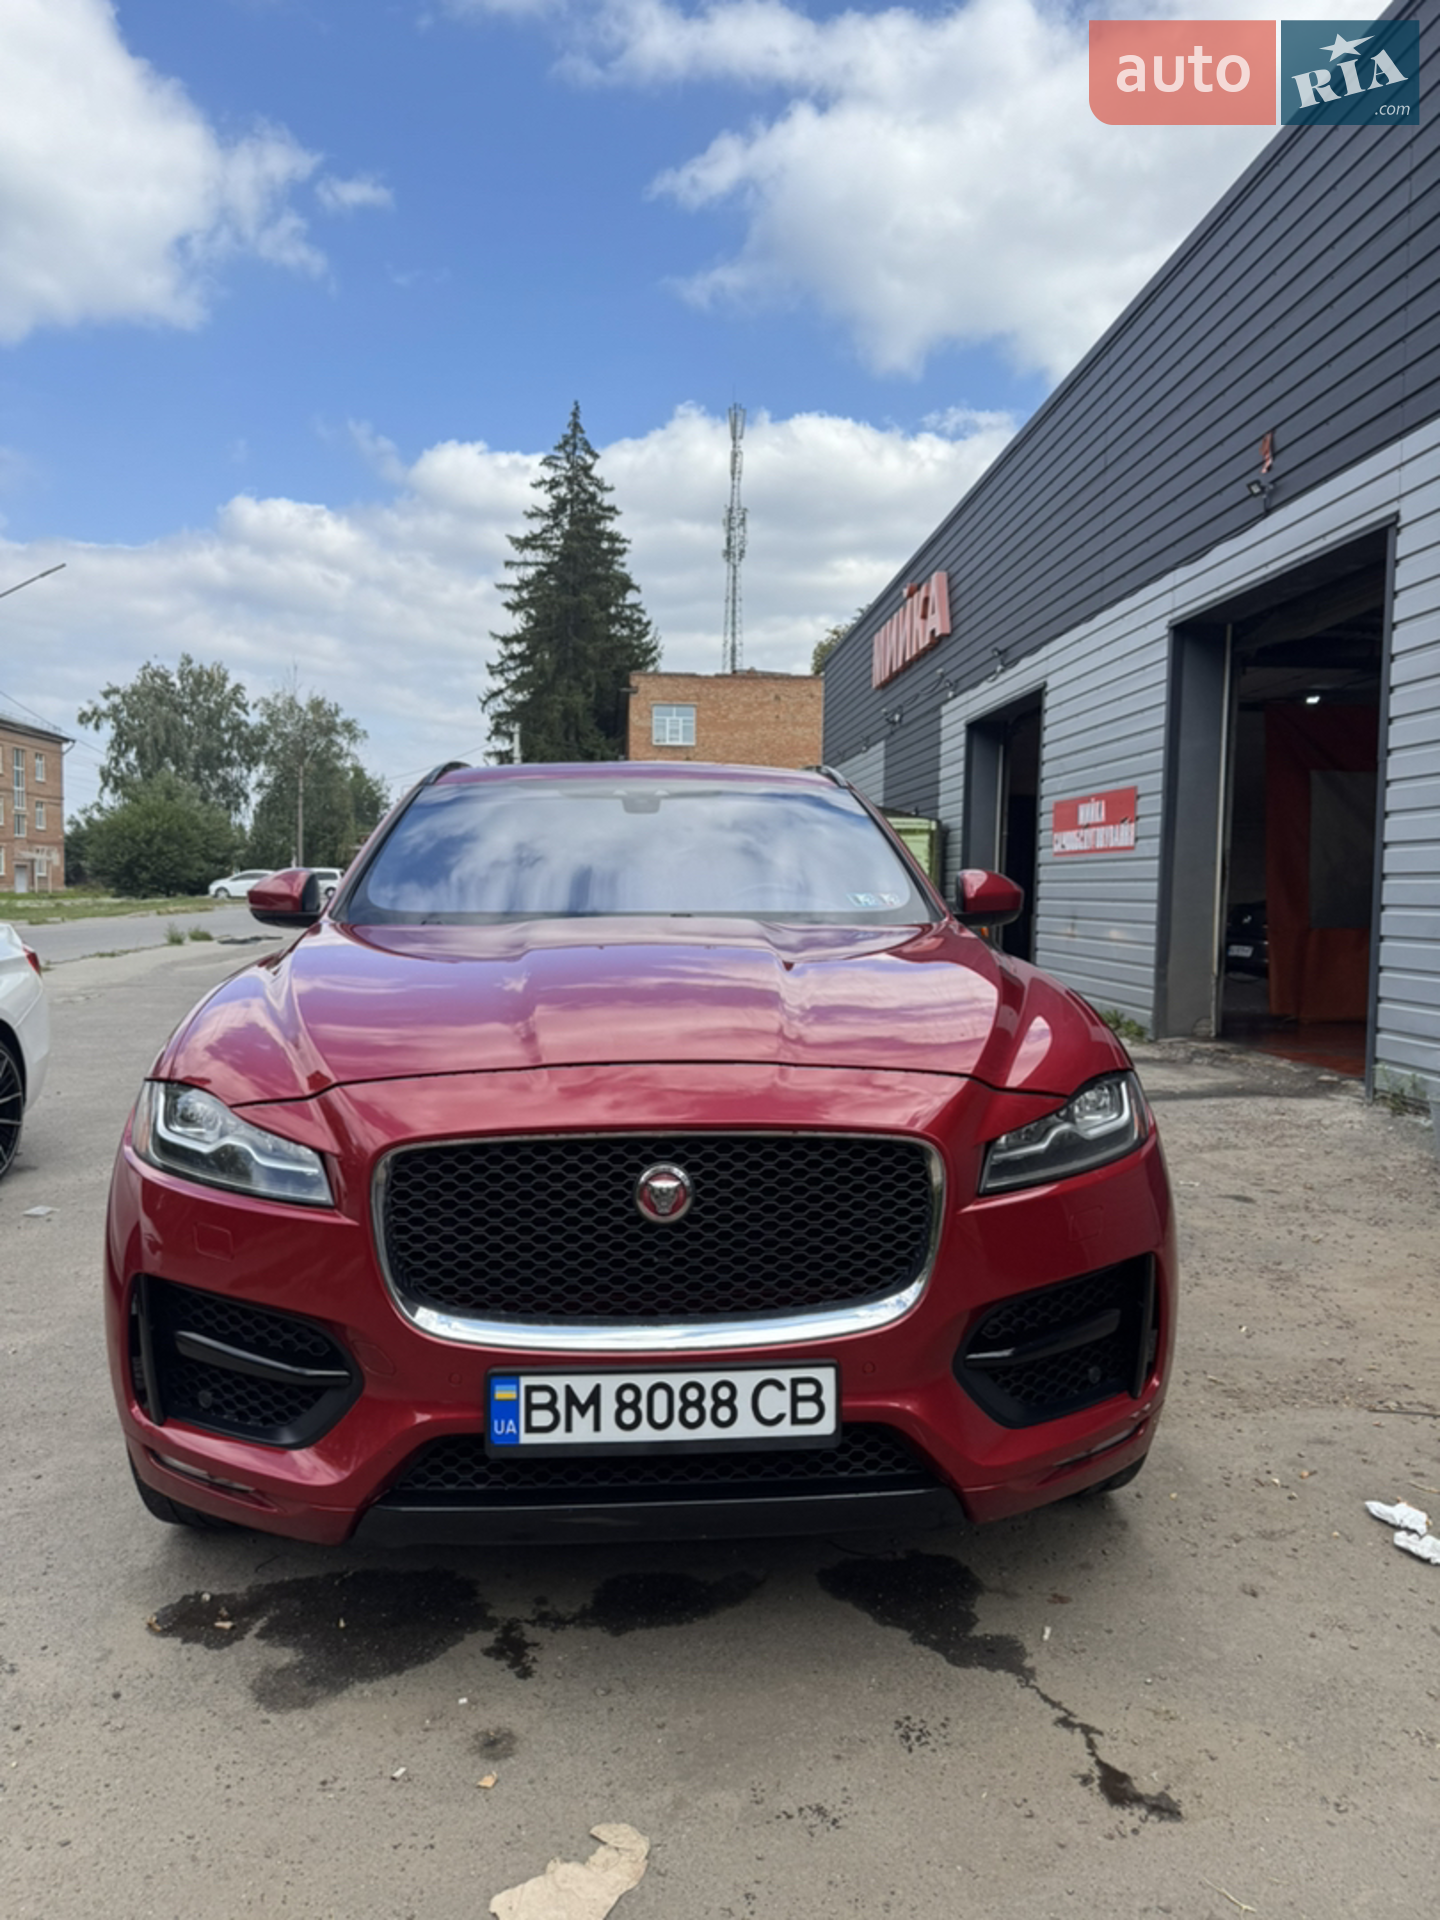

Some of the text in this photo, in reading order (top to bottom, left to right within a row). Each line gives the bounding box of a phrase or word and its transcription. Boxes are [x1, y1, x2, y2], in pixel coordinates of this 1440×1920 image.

[524, 1377, 826, 1434] BM 8088 CB
[494, 1419, 517, 1435] UA
